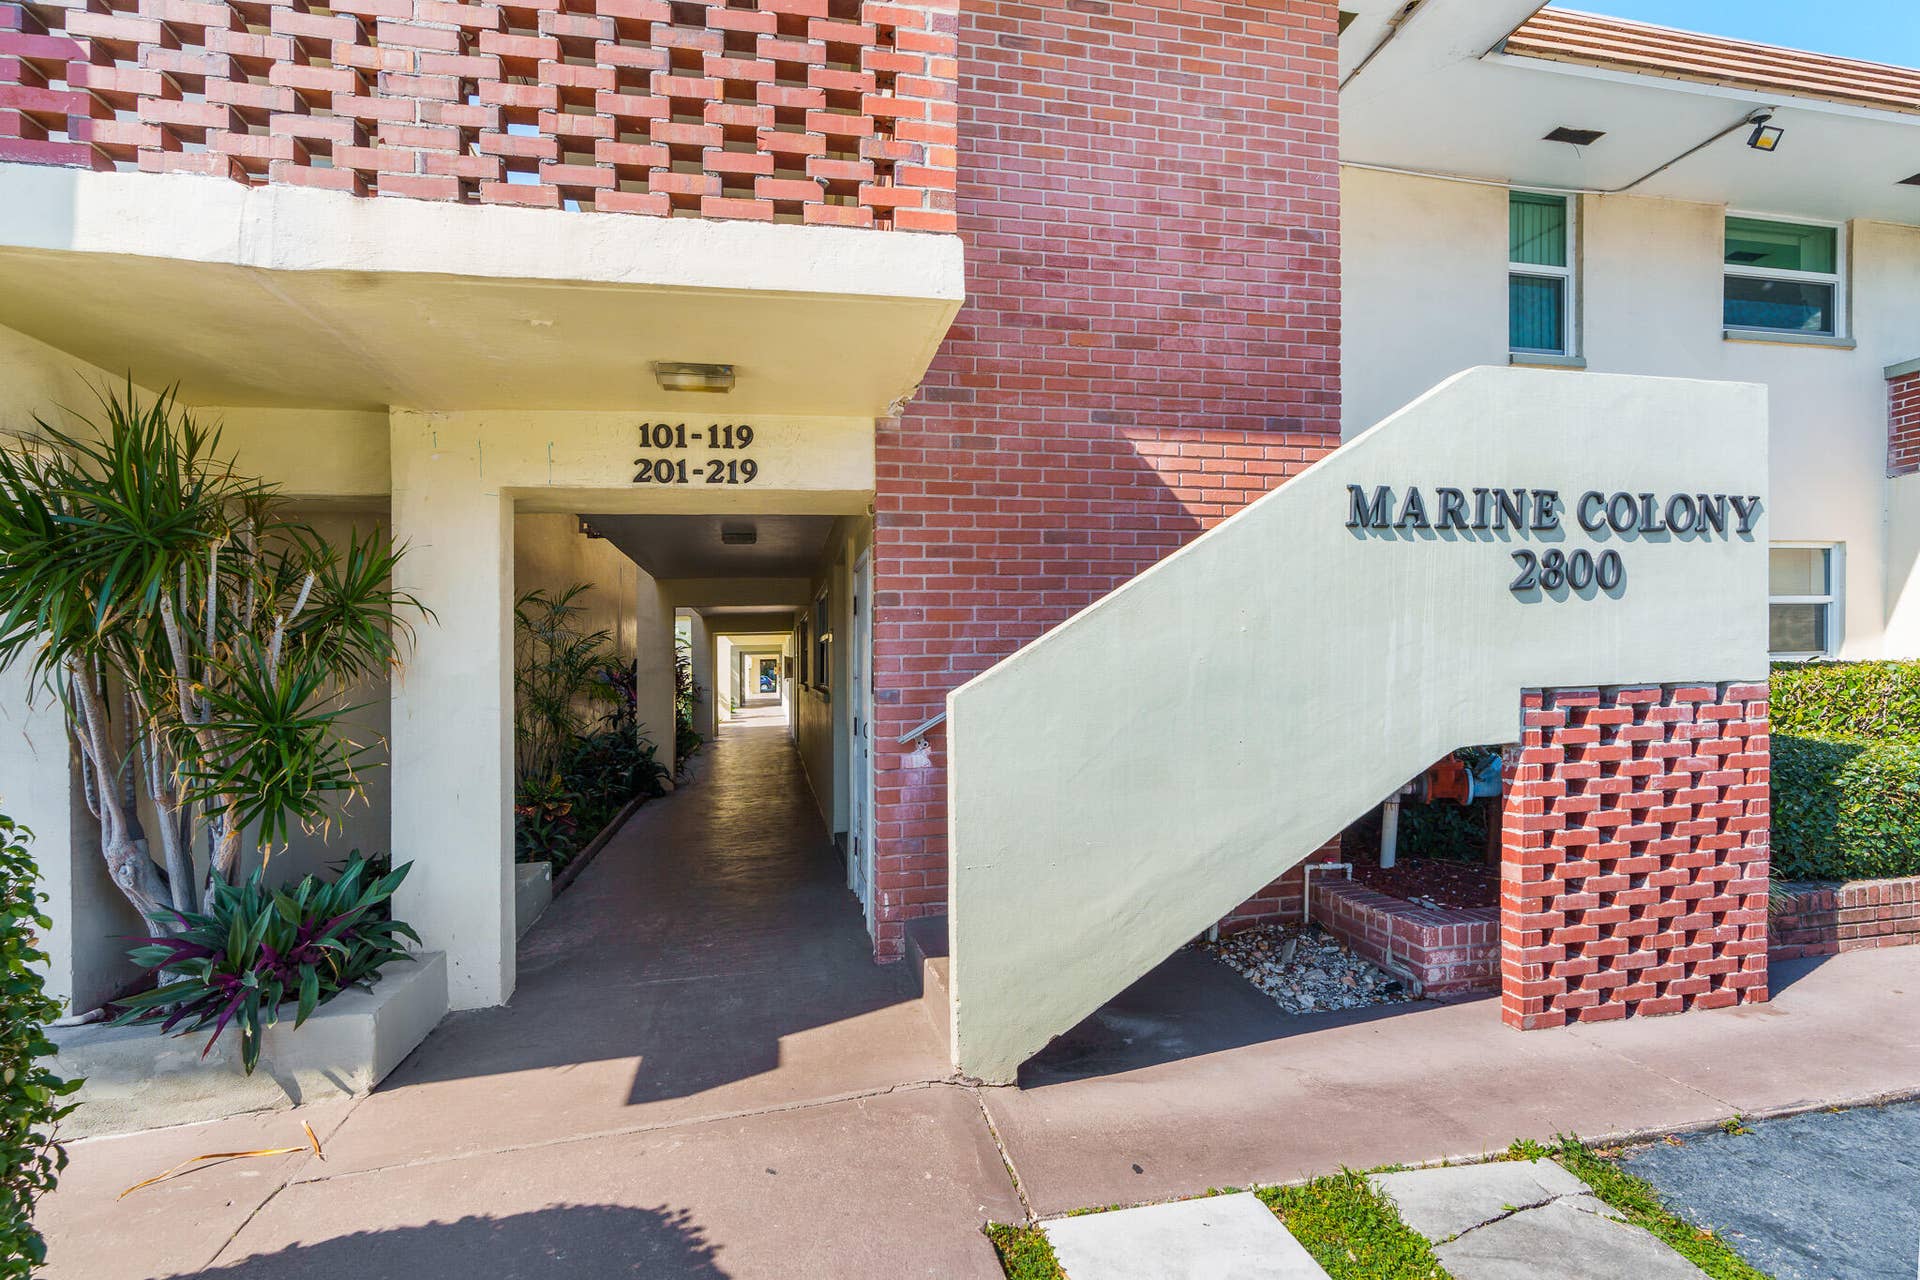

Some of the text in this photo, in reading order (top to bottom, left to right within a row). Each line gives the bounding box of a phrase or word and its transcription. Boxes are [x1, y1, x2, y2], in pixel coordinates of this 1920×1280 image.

[639, 423, 754, 449] 101-119
[633, 458, 758, 484] 201-219
[1345, 484, 1761, 534] MARINE COLONY
[1508, 548, 1623, 591] 2800
